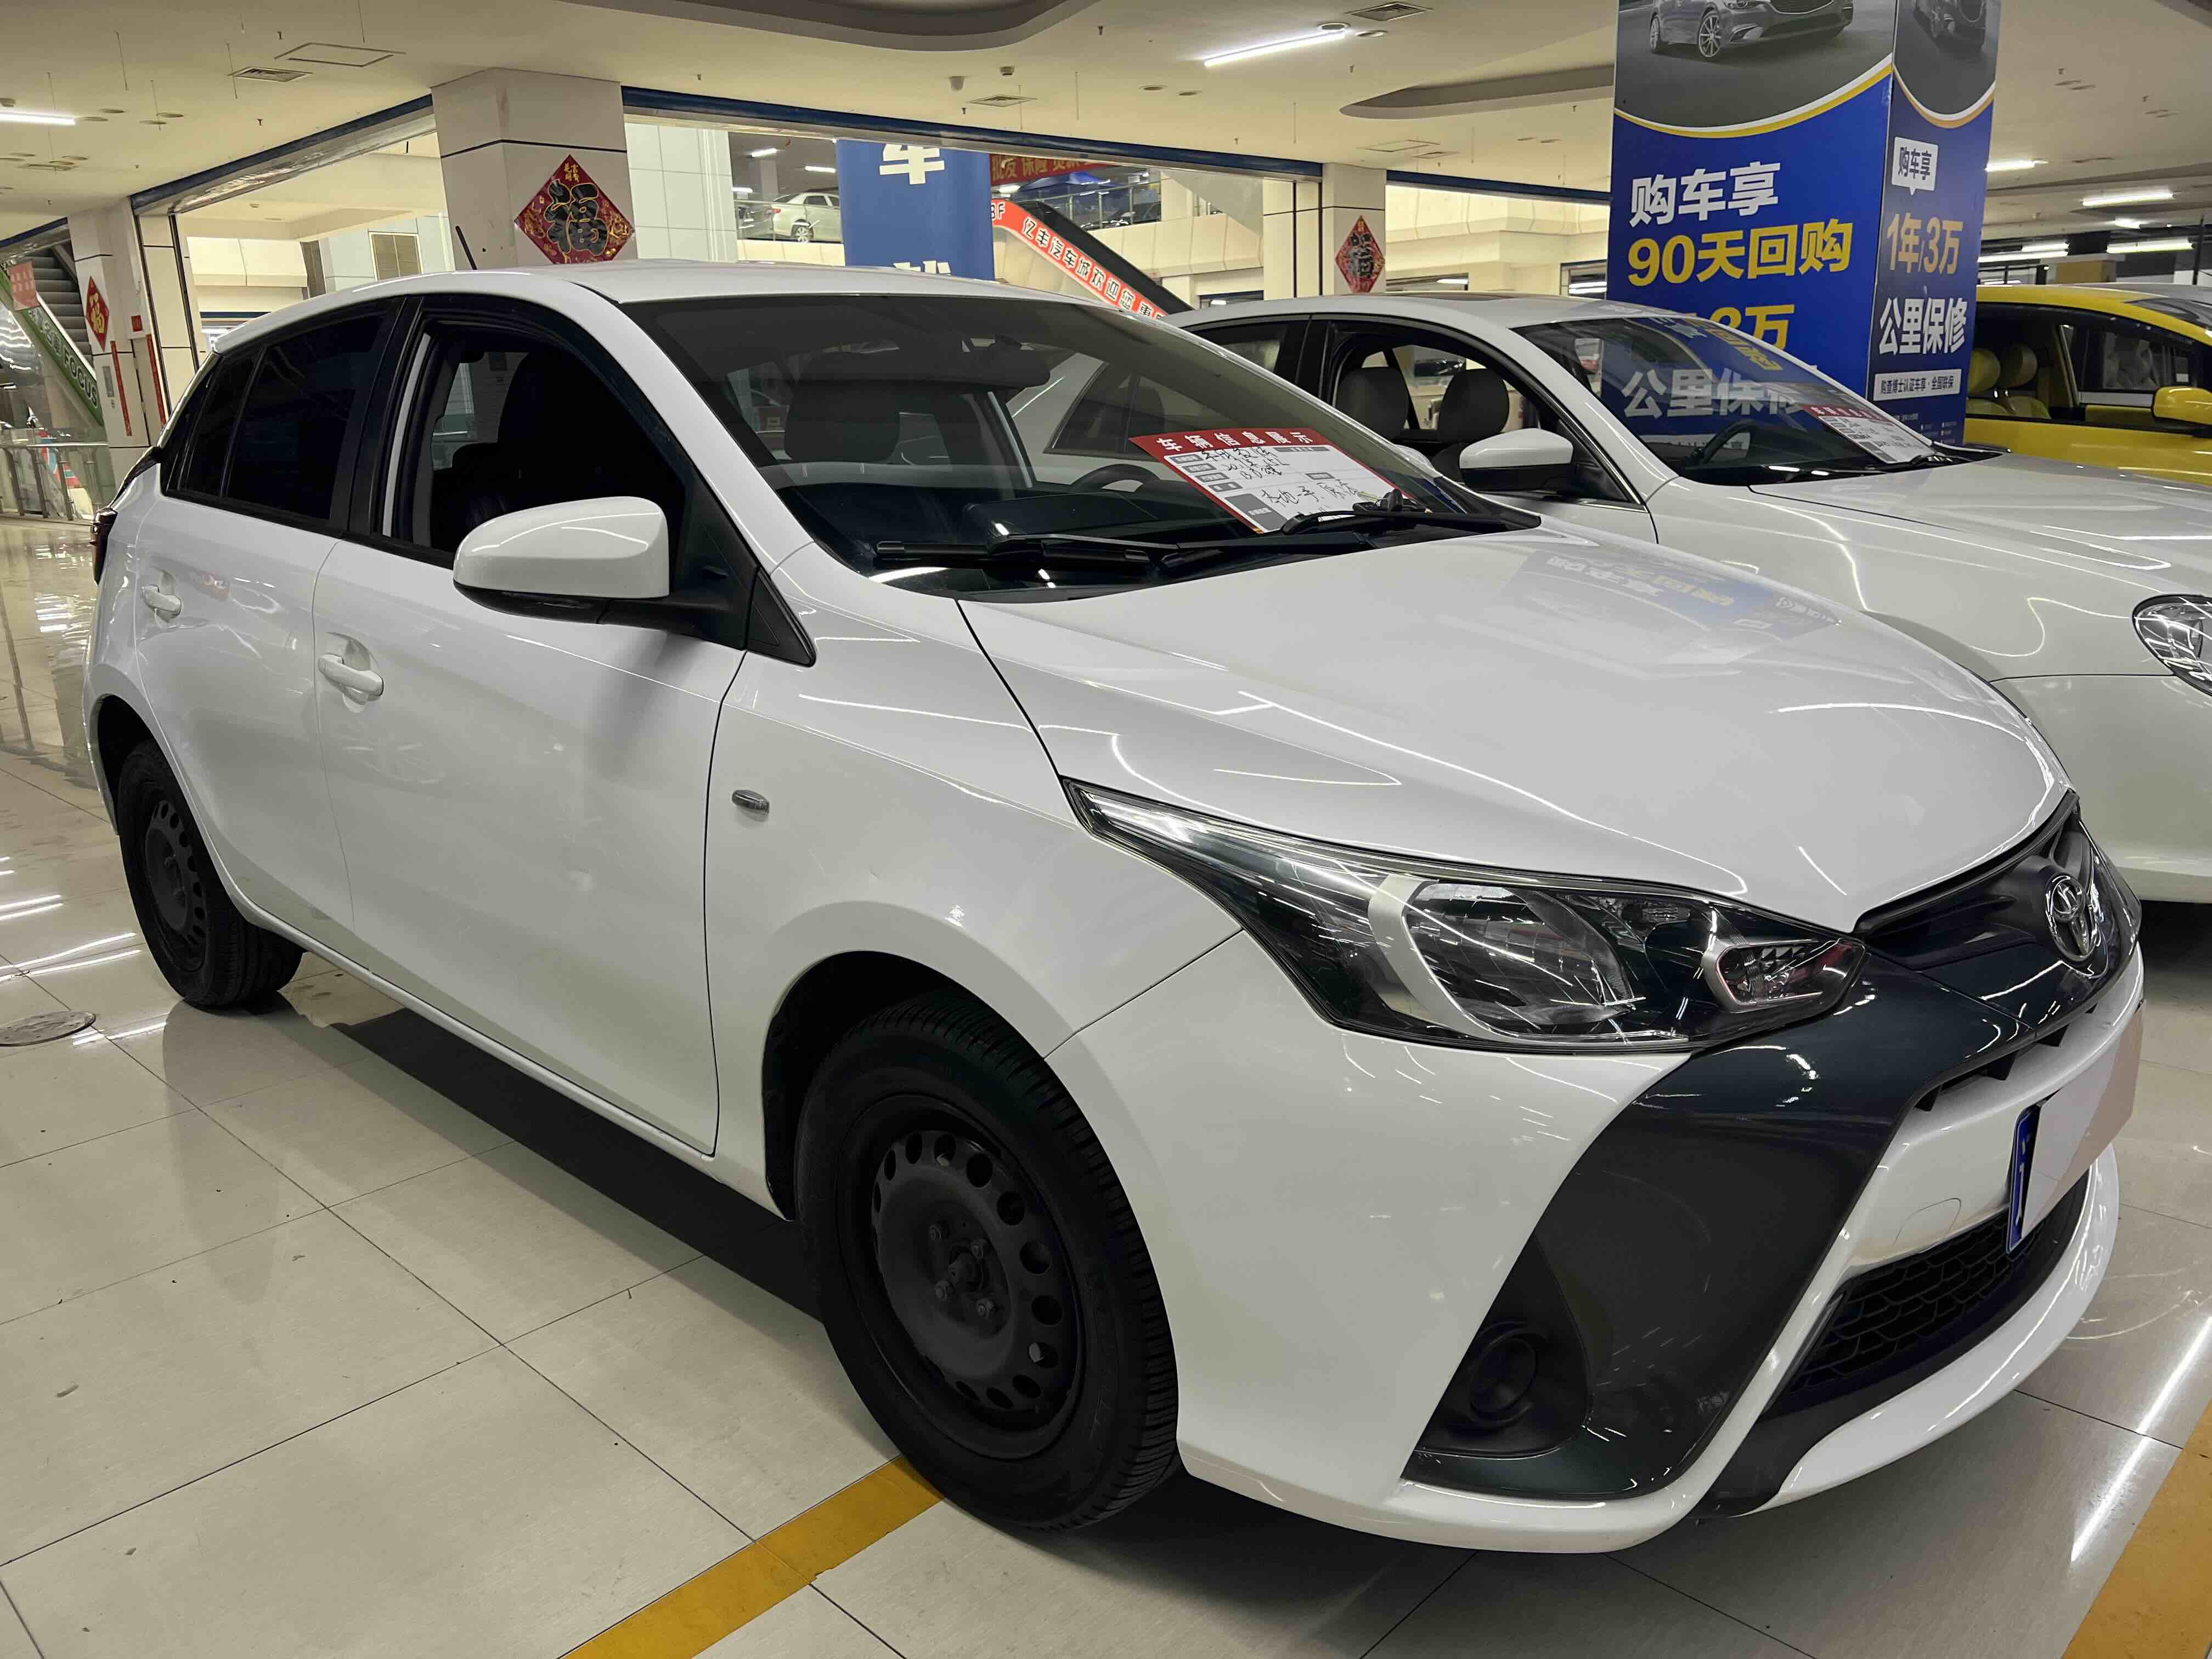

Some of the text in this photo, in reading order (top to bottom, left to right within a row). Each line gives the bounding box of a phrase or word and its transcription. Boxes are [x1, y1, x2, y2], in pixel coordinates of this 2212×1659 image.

[1898, 146, 1932, 180] 购车享
[1629, 161, 1781, 228] 购车享
[1627, 218, 1853, 286] 90天回购
[1887, 212, 1963, 274] 1年/3万
[1879, 297, 1968, 355] 公里保修
[1156, 431, 1314, 452] 车辆信息展示
